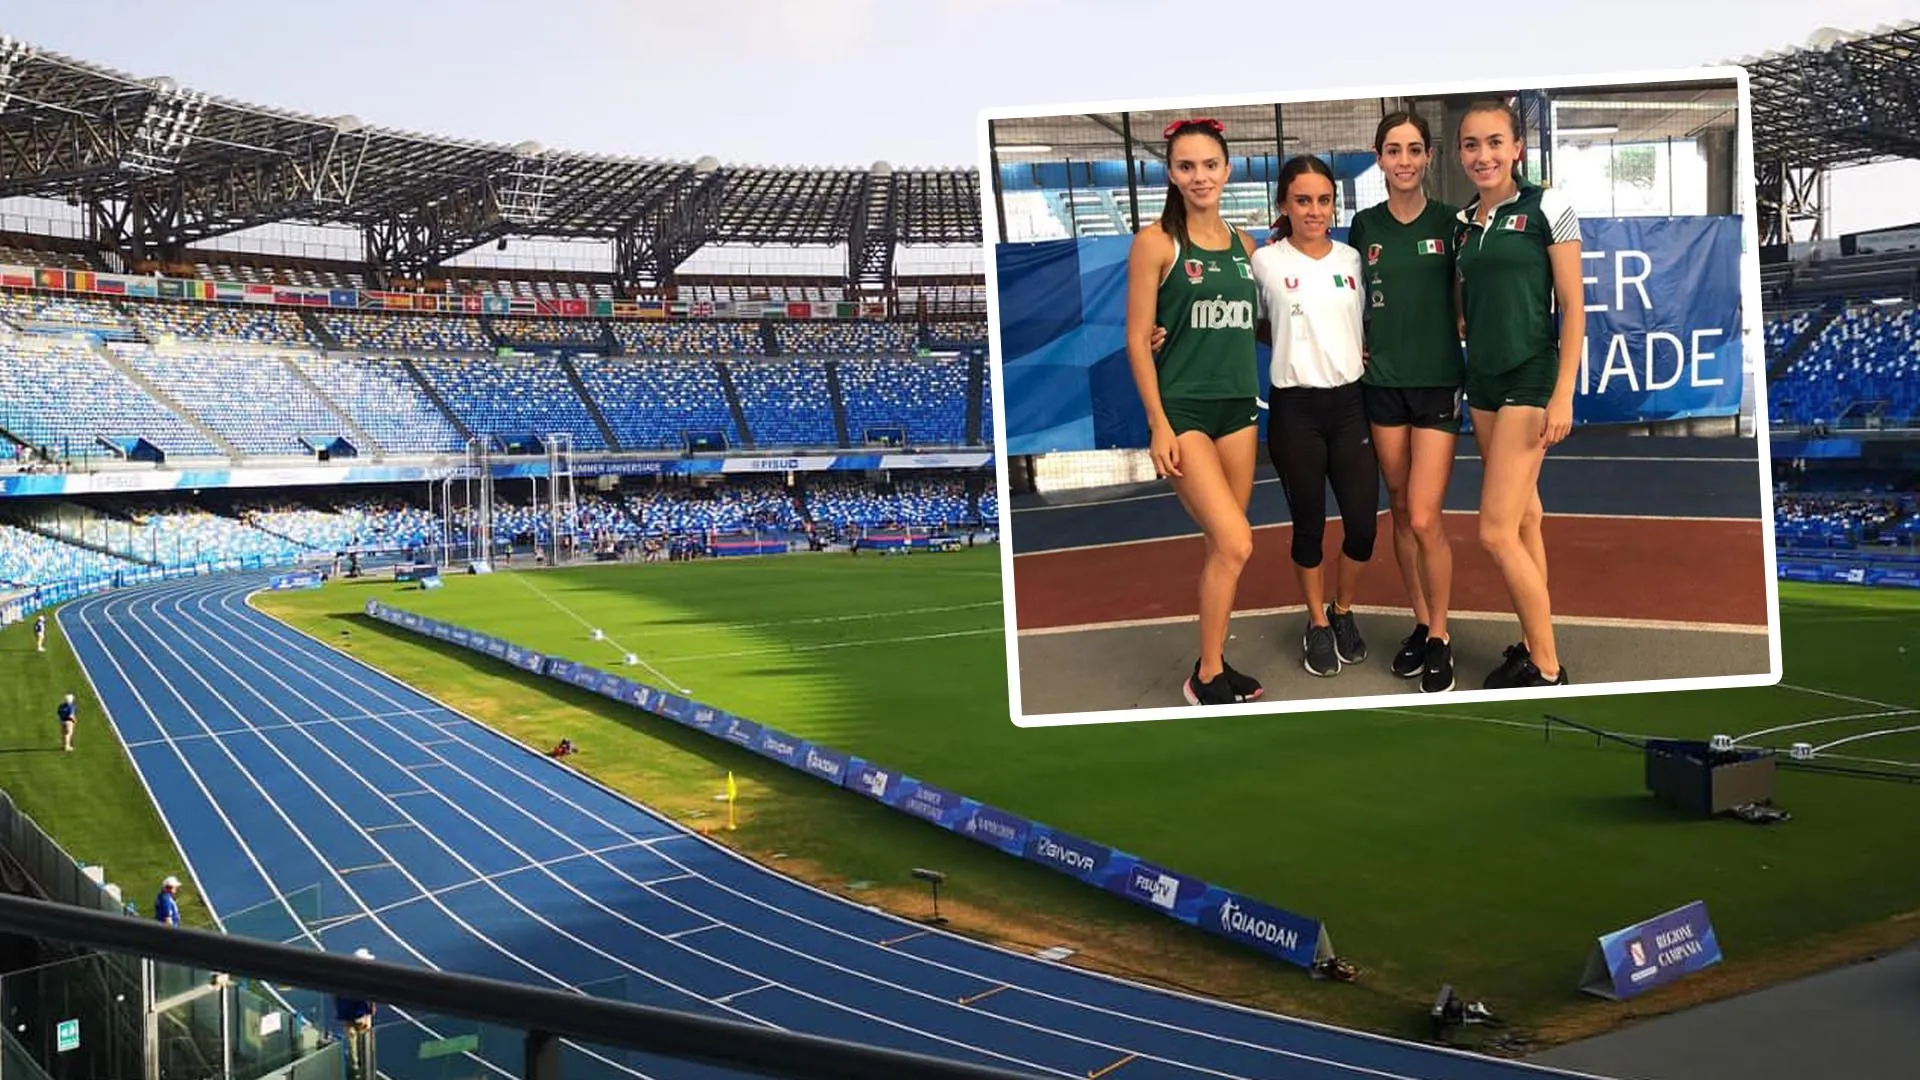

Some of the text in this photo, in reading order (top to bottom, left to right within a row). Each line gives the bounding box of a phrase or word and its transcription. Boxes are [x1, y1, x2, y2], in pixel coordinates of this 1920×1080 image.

[1580, 328, 1725, 396] IADE
[1231, 910, 1298, 952] QIAODAN
[1656, 924, 1692, 949] REGIONE
[1658, 941, 1702, 966] CAMPANIA
